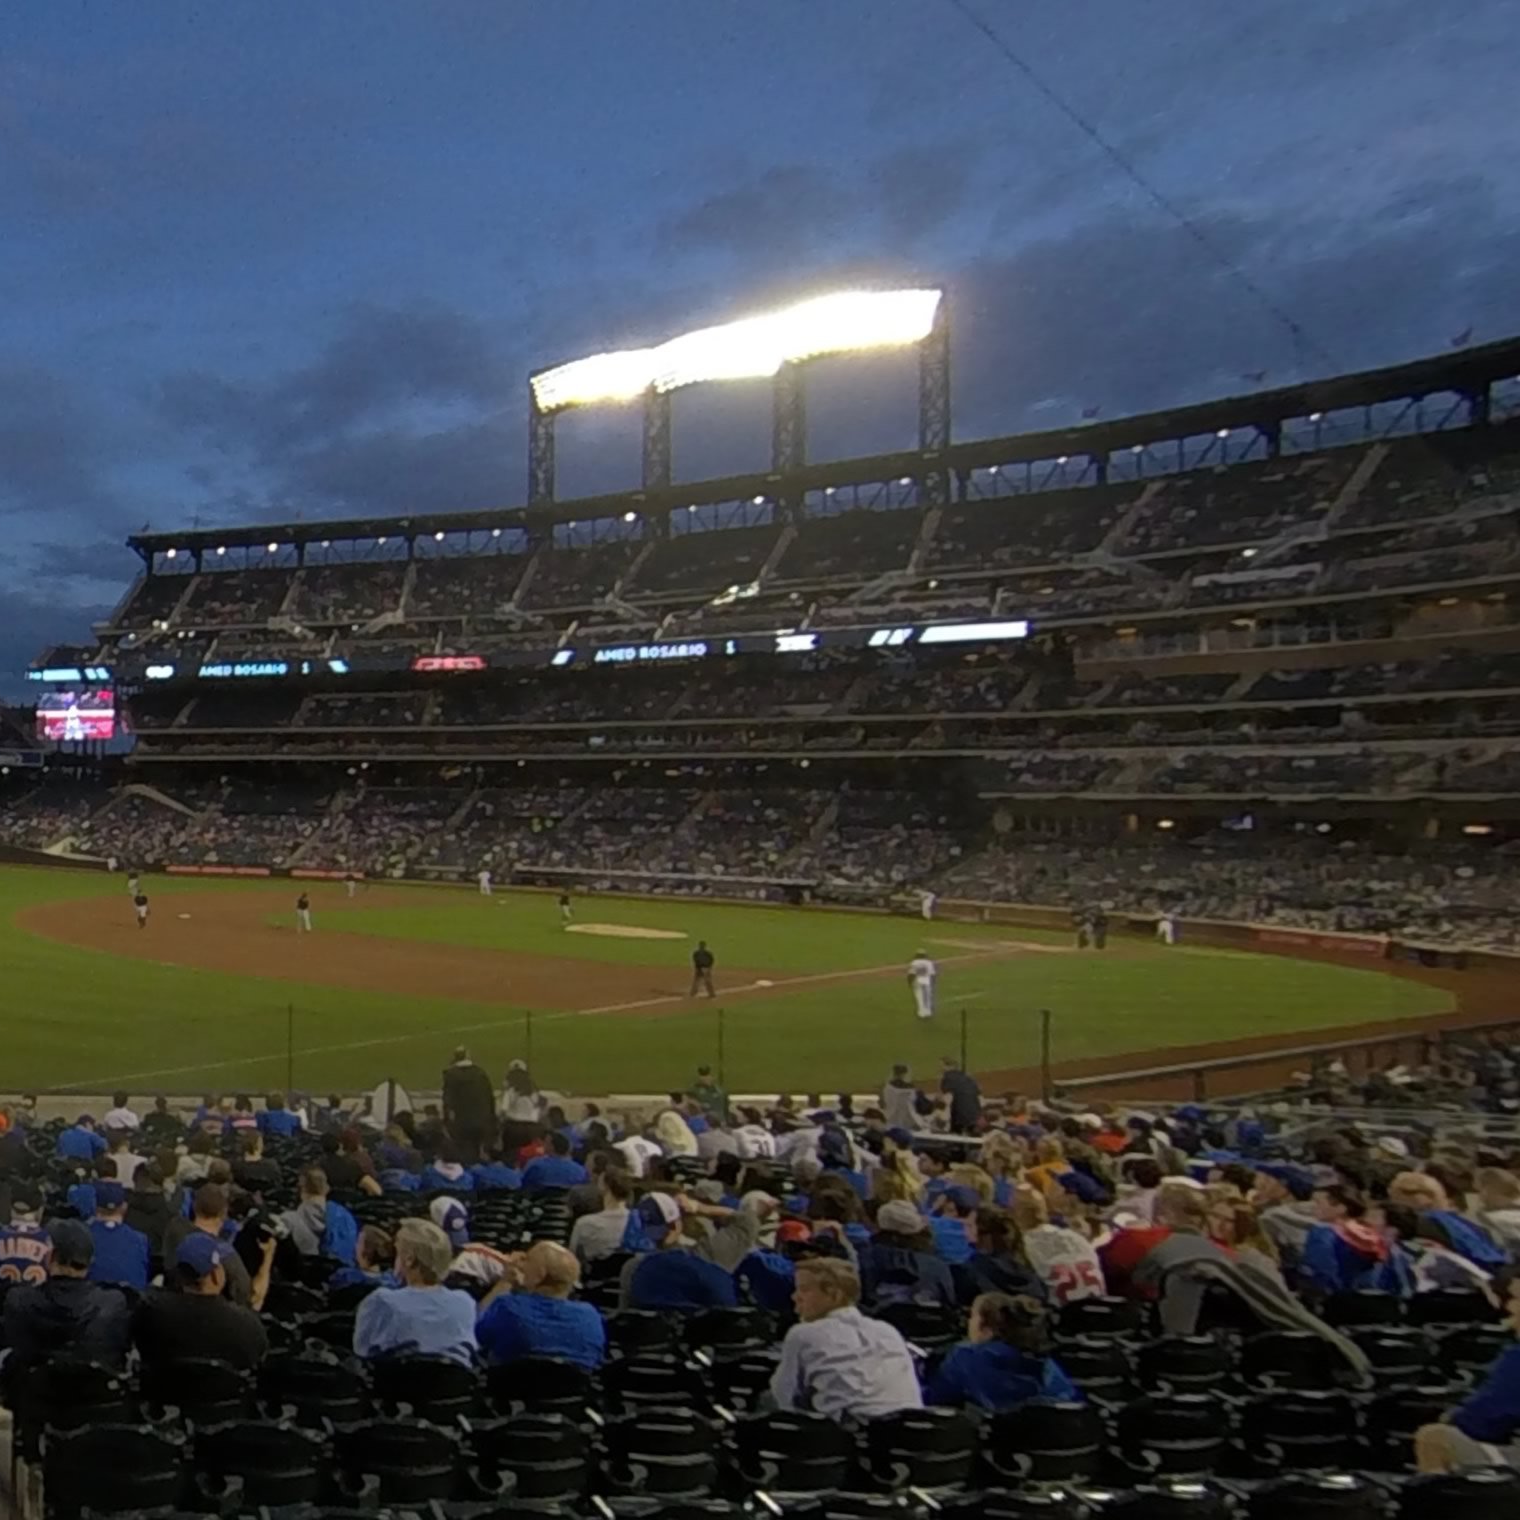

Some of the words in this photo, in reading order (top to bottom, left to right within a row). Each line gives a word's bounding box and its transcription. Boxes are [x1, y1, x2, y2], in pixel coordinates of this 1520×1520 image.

[594, 648, 636, 663] AMED
[639, 643, 707, 660] ROSARIO
[197, 664, 232, 678] AMED
